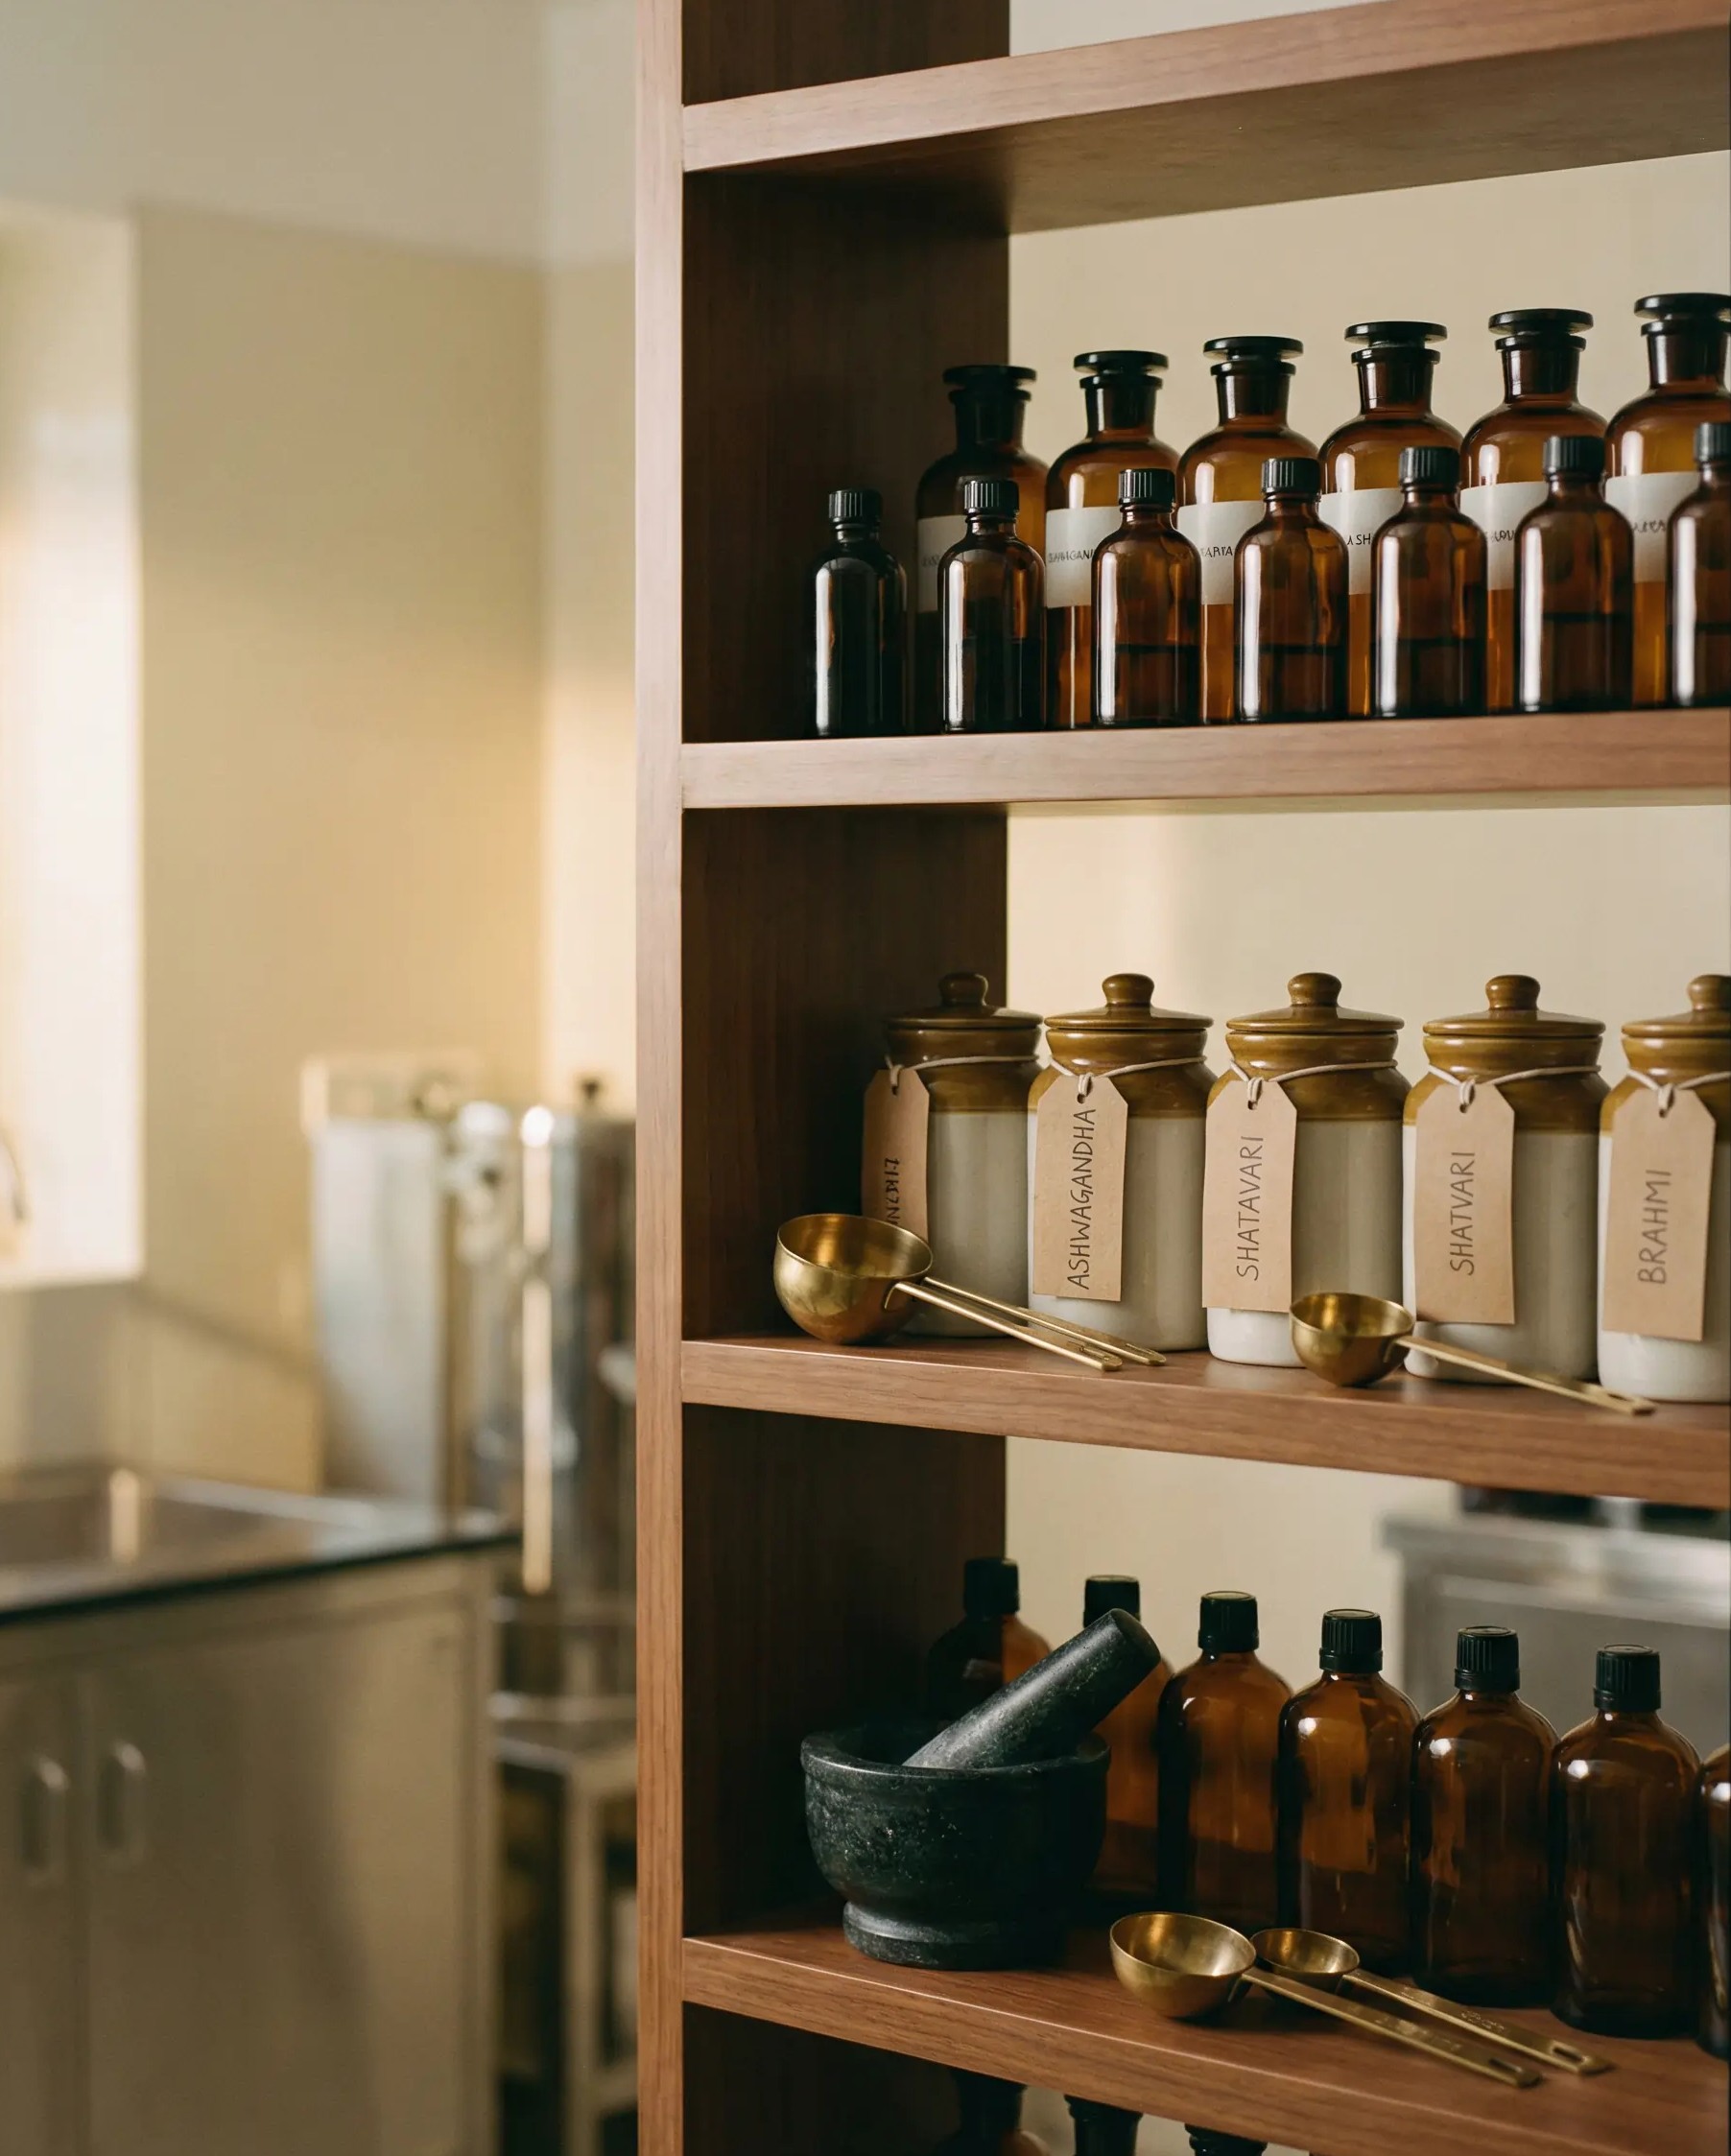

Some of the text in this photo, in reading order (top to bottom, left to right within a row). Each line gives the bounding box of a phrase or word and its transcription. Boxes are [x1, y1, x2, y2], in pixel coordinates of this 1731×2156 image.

[1067, 1109, 1097, 1290] ASHWAGANDHA
[1236, 1136, 1264, 1281] SHATAVARI
[1449, 1152, 1476, 1276] SHATVARI
[1637, 1169, 1672, 1285] BRAHMI
